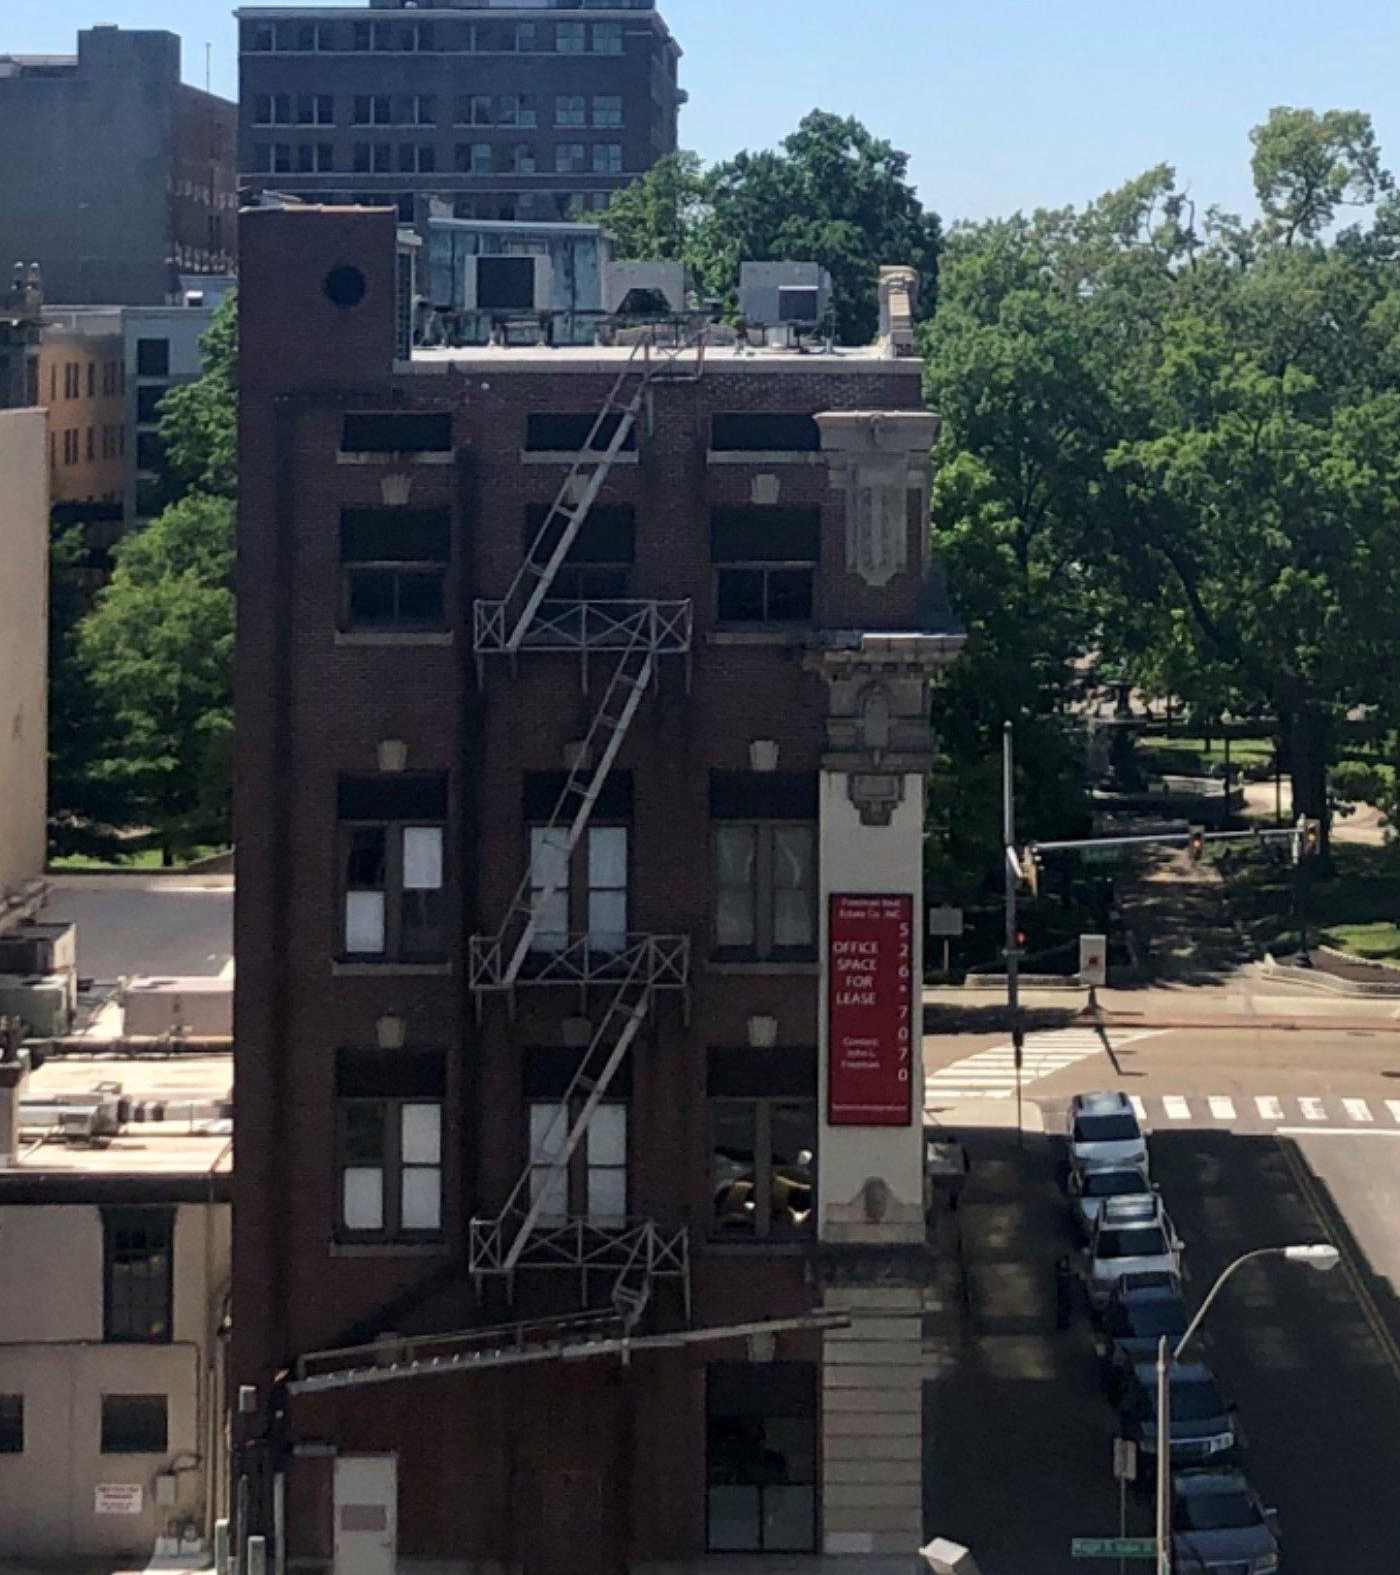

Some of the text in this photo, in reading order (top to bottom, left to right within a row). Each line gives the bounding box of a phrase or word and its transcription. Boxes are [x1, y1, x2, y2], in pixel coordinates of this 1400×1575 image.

[833, 941, 878, 955] OFFICE
[837, 958, 877, 972] SPACE
[846, 975, 873, 988] FOR
[836, 992, 877, 1005] LEASE
